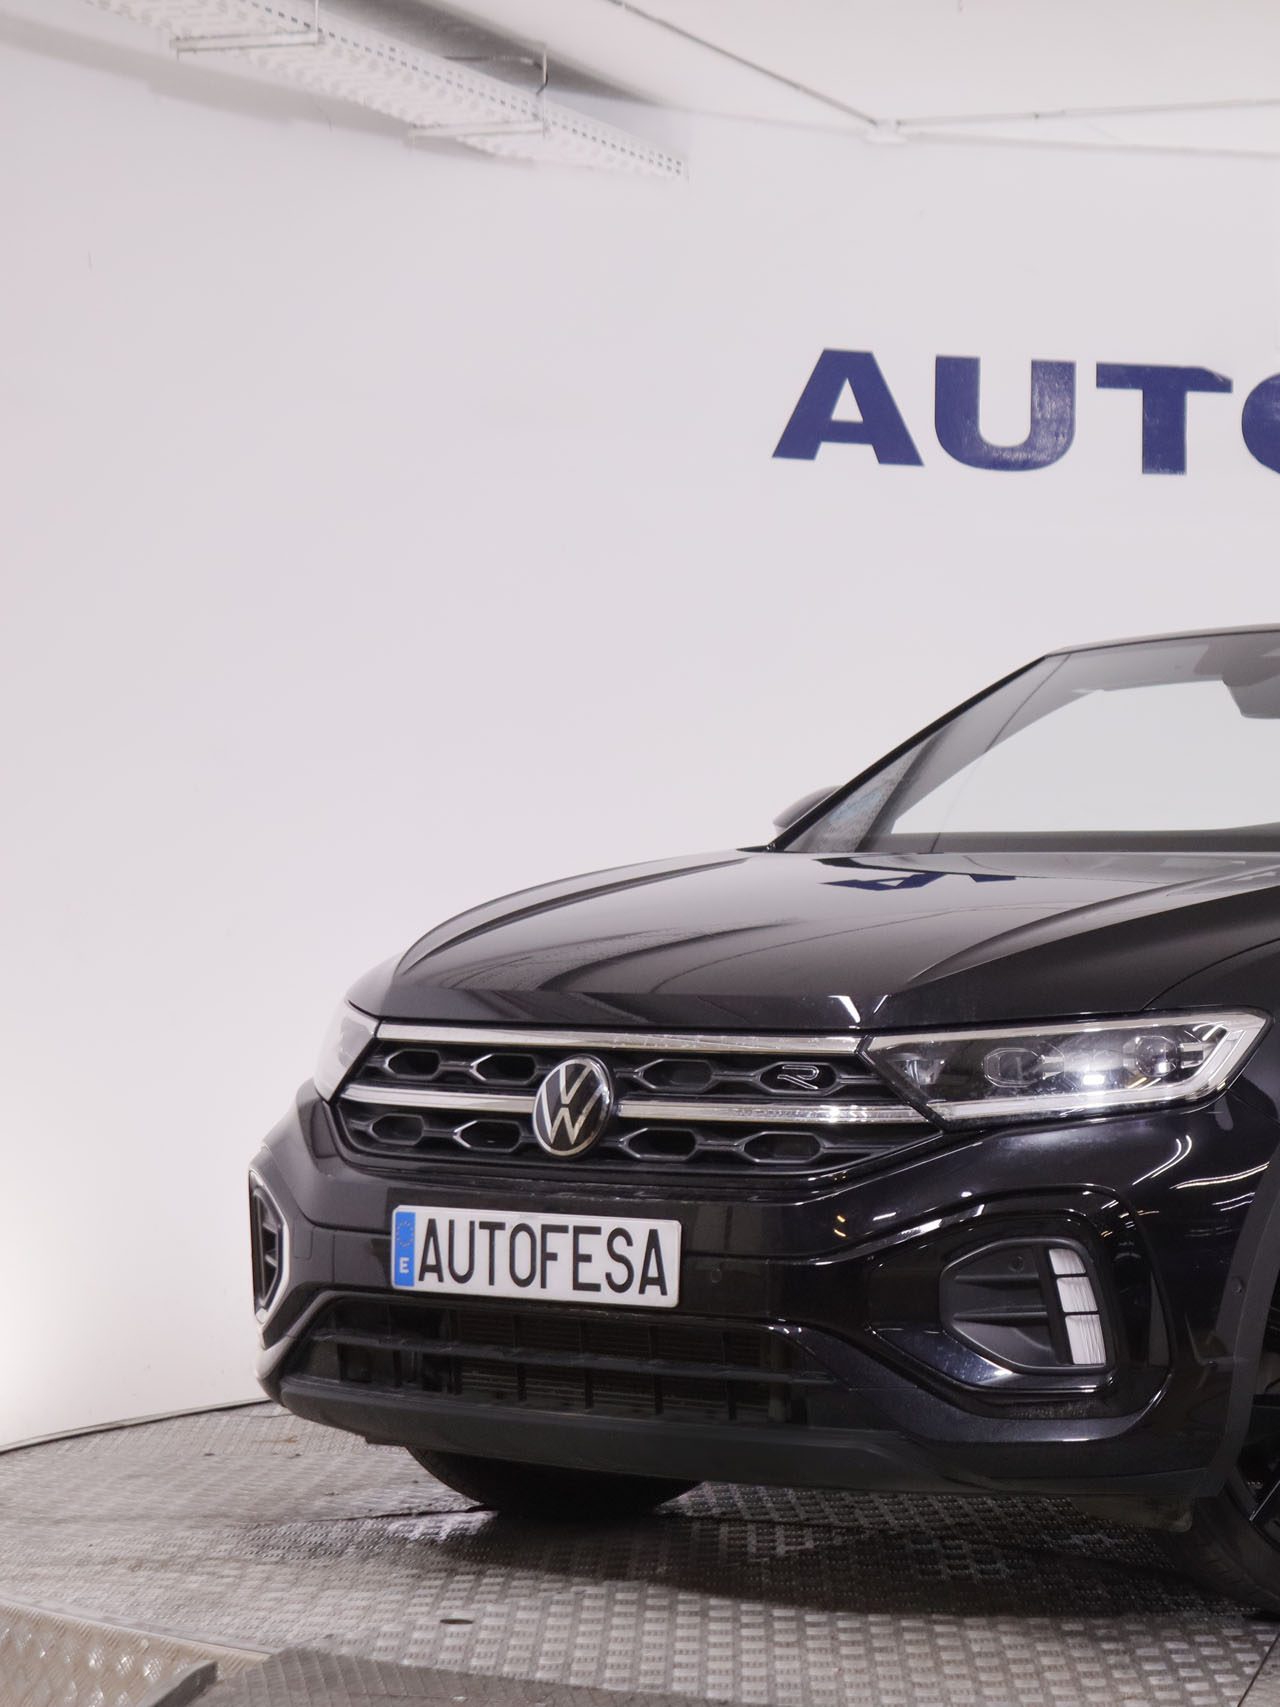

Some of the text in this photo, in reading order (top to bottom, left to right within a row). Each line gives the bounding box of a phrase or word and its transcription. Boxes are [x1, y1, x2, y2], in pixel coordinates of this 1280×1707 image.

[536, 1058, 608, 1151] VW
[399, 1256, 410, 1273] E
[418, 1218, 668, 1296] AUTOFESA
